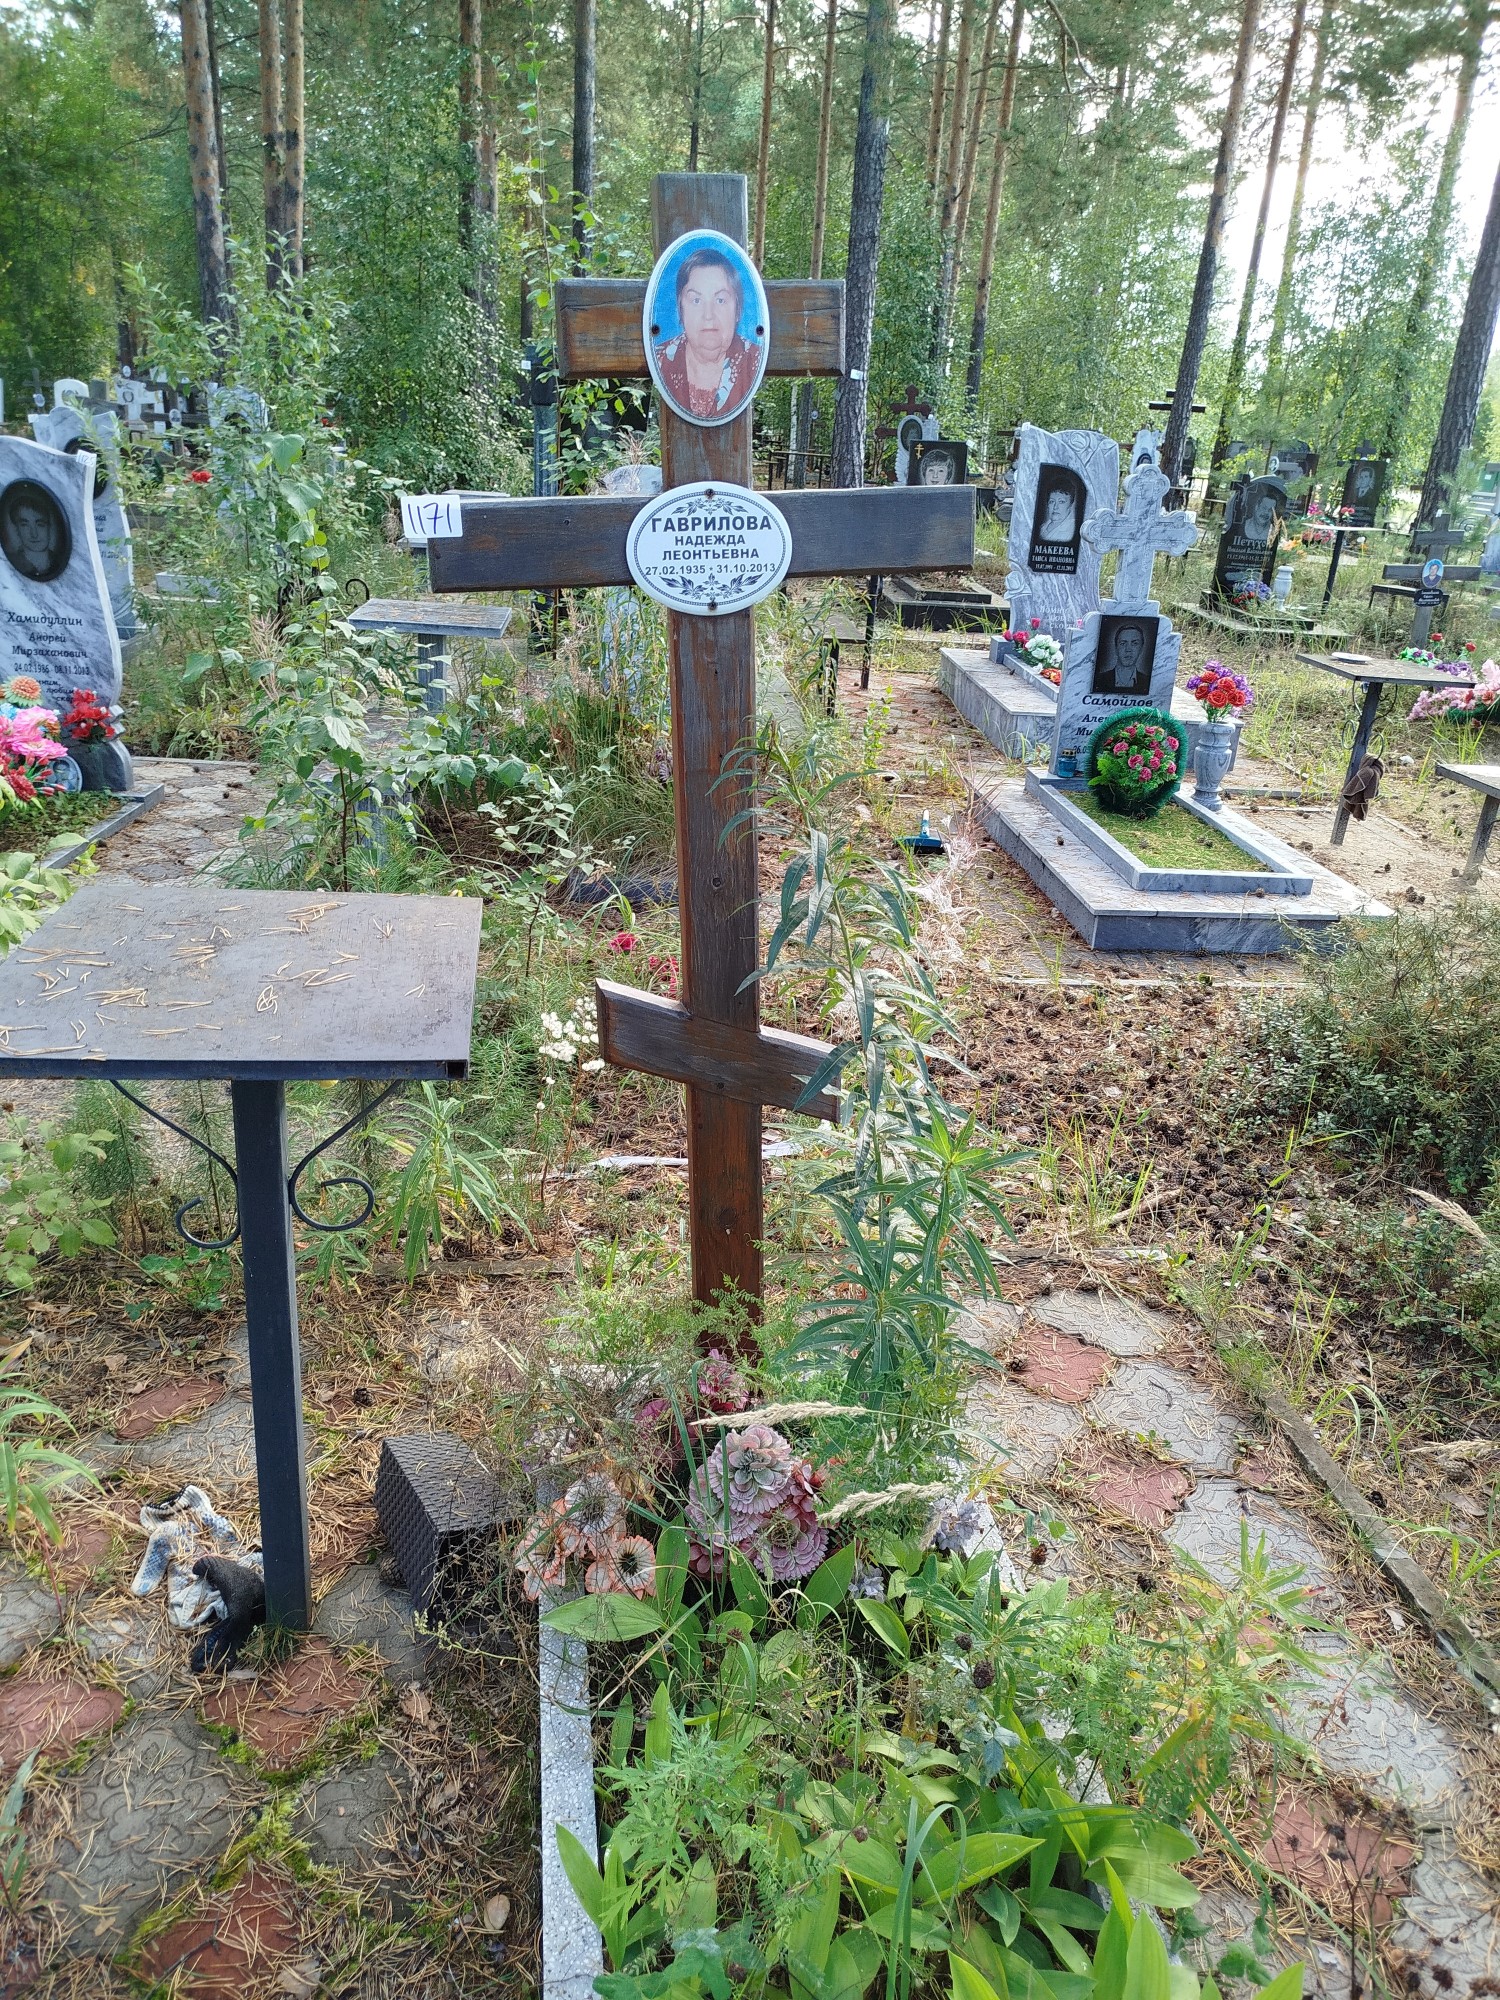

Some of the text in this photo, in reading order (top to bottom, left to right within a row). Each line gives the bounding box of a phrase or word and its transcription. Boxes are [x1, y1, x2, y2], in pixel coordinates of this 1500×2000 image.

[408, 503, 452, 535] 1171
[651, 516, 772, 532] ГАВРИЛОВА
[675, 535, 746, 547] НАДЕЖДА
[662, 548, 760, 561] ЛЕОНТЬЕВНА
[1034, 545, 1075, 556] МАКЕЕВА
[645, 563, 776, 576] 27.02.1935 31.10.2013
[8, 612, 83, 629] Хамидуллин
[29, 632, 66, 644] Андрей
[1082, 695, 1153, 707] Самойлов
